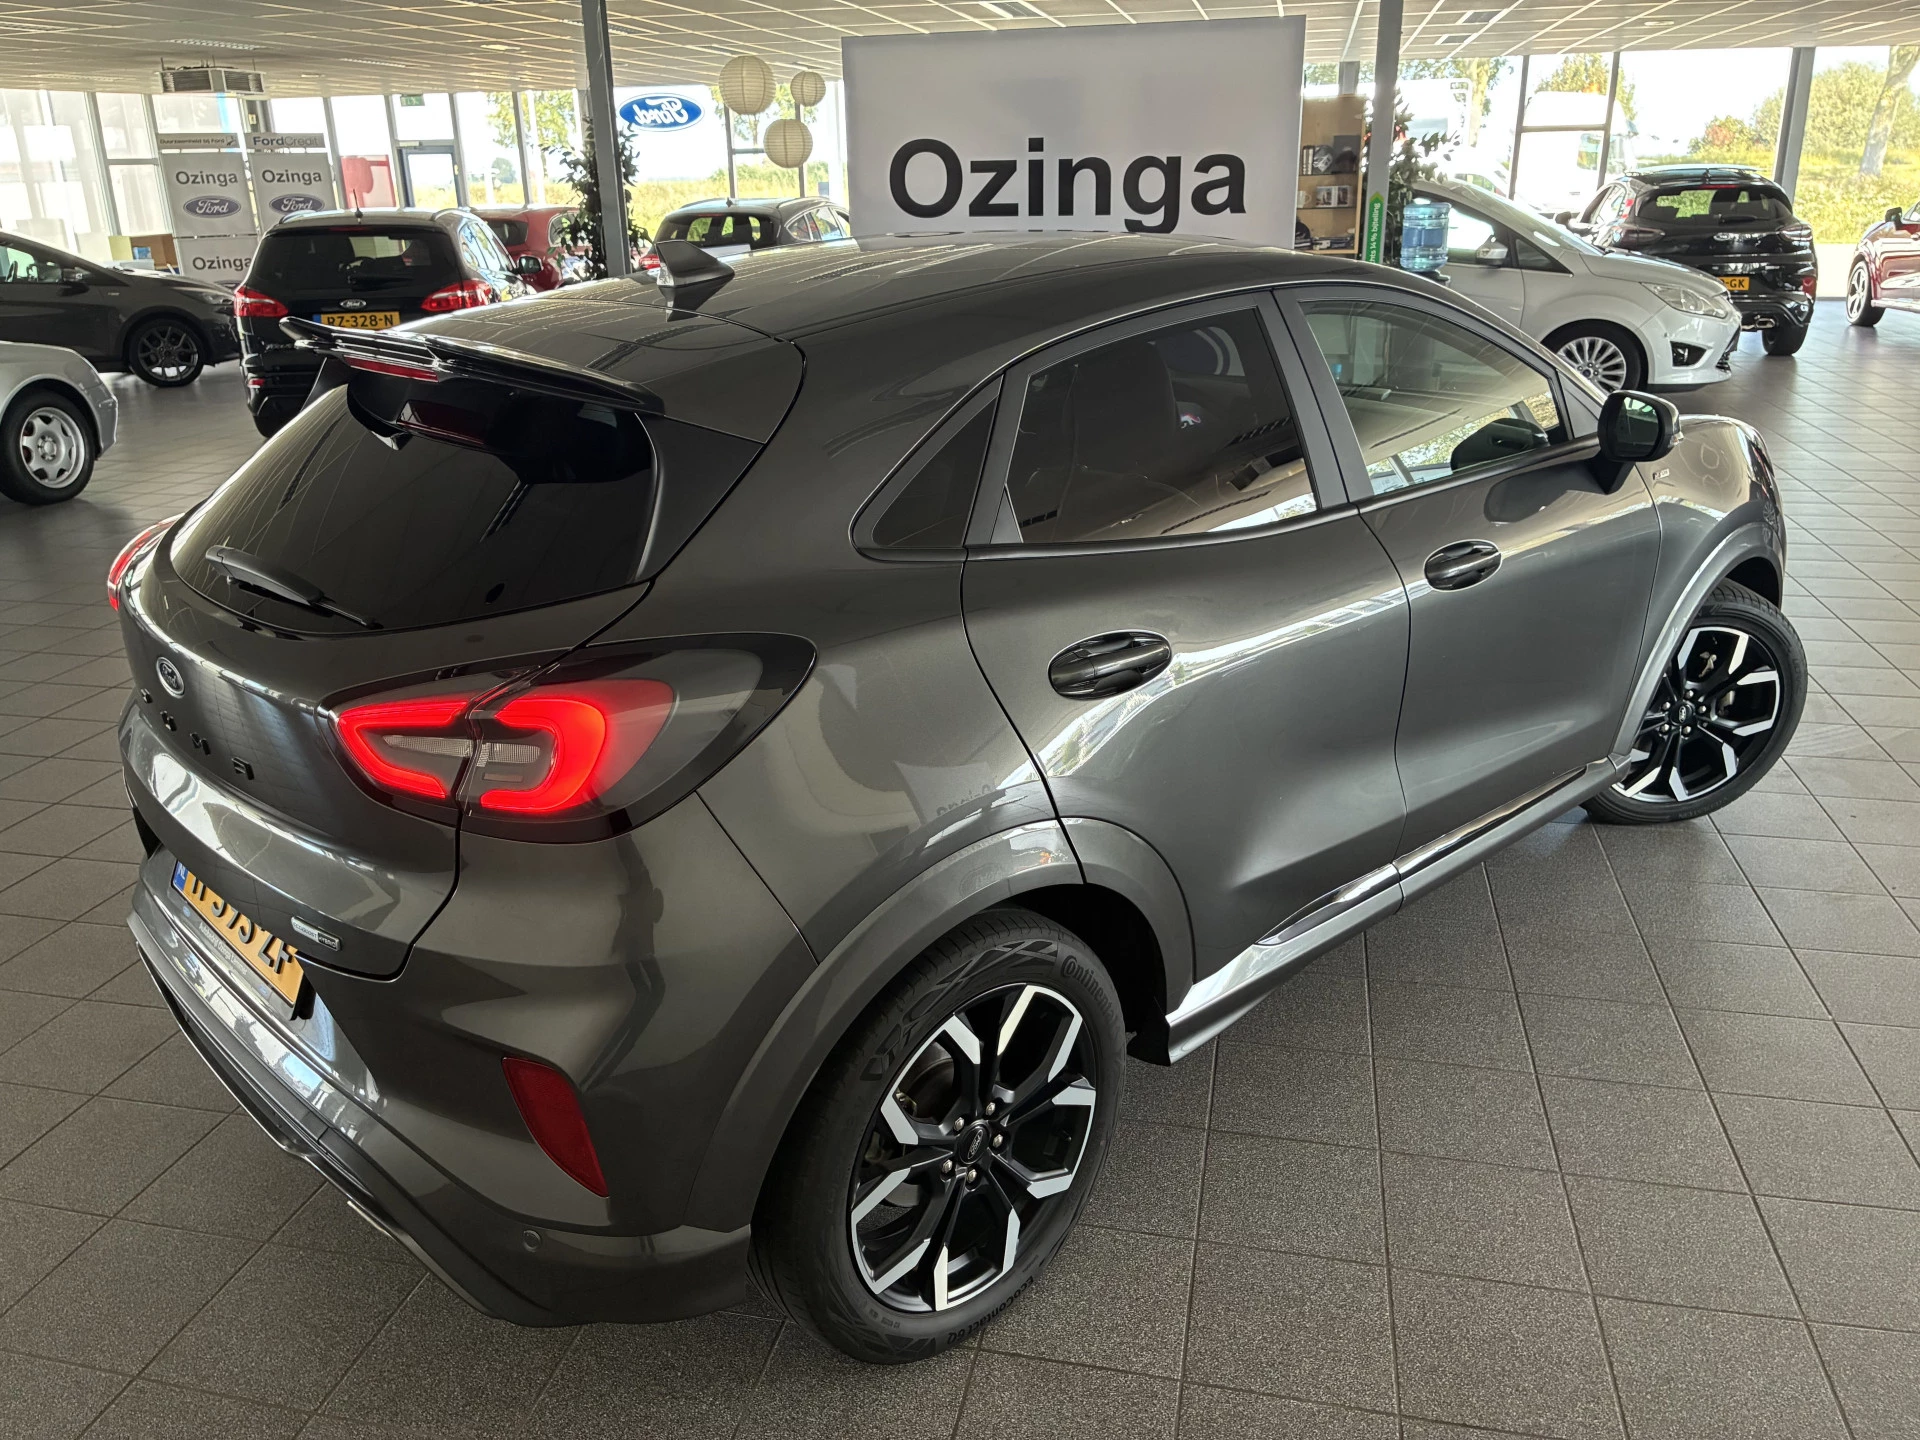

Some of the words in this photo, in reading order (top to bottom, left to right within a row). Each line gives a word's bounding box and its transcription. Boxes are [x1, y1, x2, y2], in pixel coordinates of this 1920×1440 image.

[253, 136, 319, 147] FordCredit
[175, 170, 238, 187] Ozinga
[261, 168, 322, 186] Ozinga
[889, 137, 1247, 234] Ozinga
[195, 199, 229, 214] Ford
[280, 197, 313, 212] Ford
[192, 255, 252, 272] Ozinga
[327, 314, 394, 328] RZ-328-N
